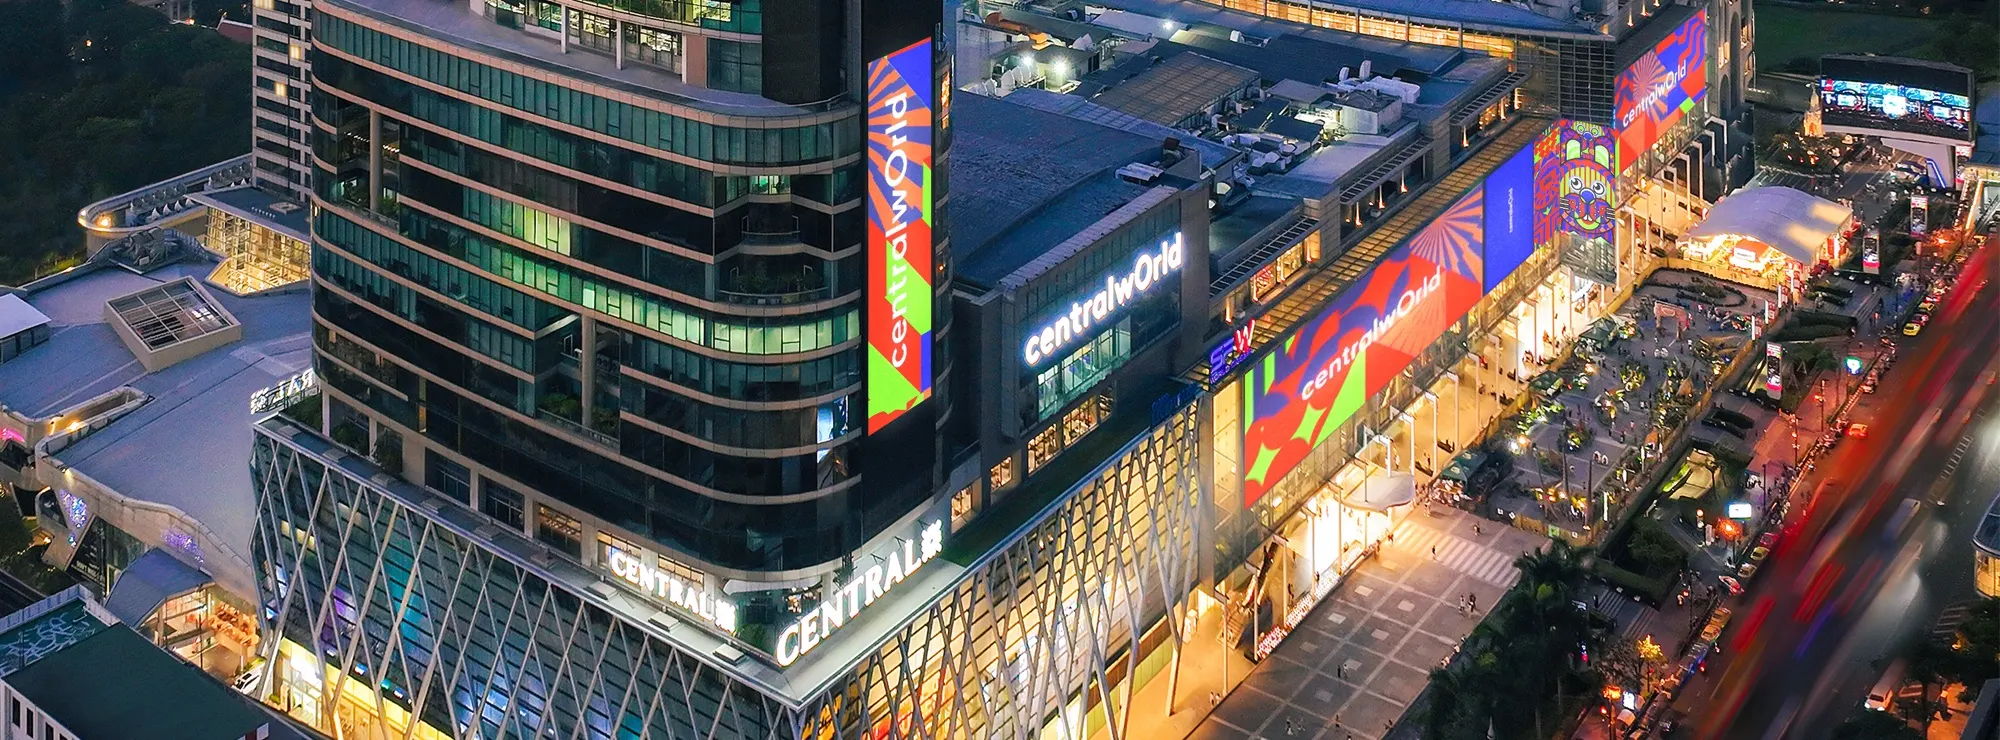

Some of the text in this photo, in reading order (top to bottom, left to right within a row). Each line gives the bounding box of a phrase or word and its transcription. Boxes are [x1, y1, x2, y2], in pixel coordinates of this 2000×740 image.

[1622, 60, 1687, 128] centralwOrld
[885, 91, 908, 368] centralwOrld
[1024, 231, 1183, 366] centralwOrld
[1301, 265, 1441, 401] centralwOrld
[610, 551, 716, 623] CENTRAL
[775, 538, 922, 668] CENTRAL
